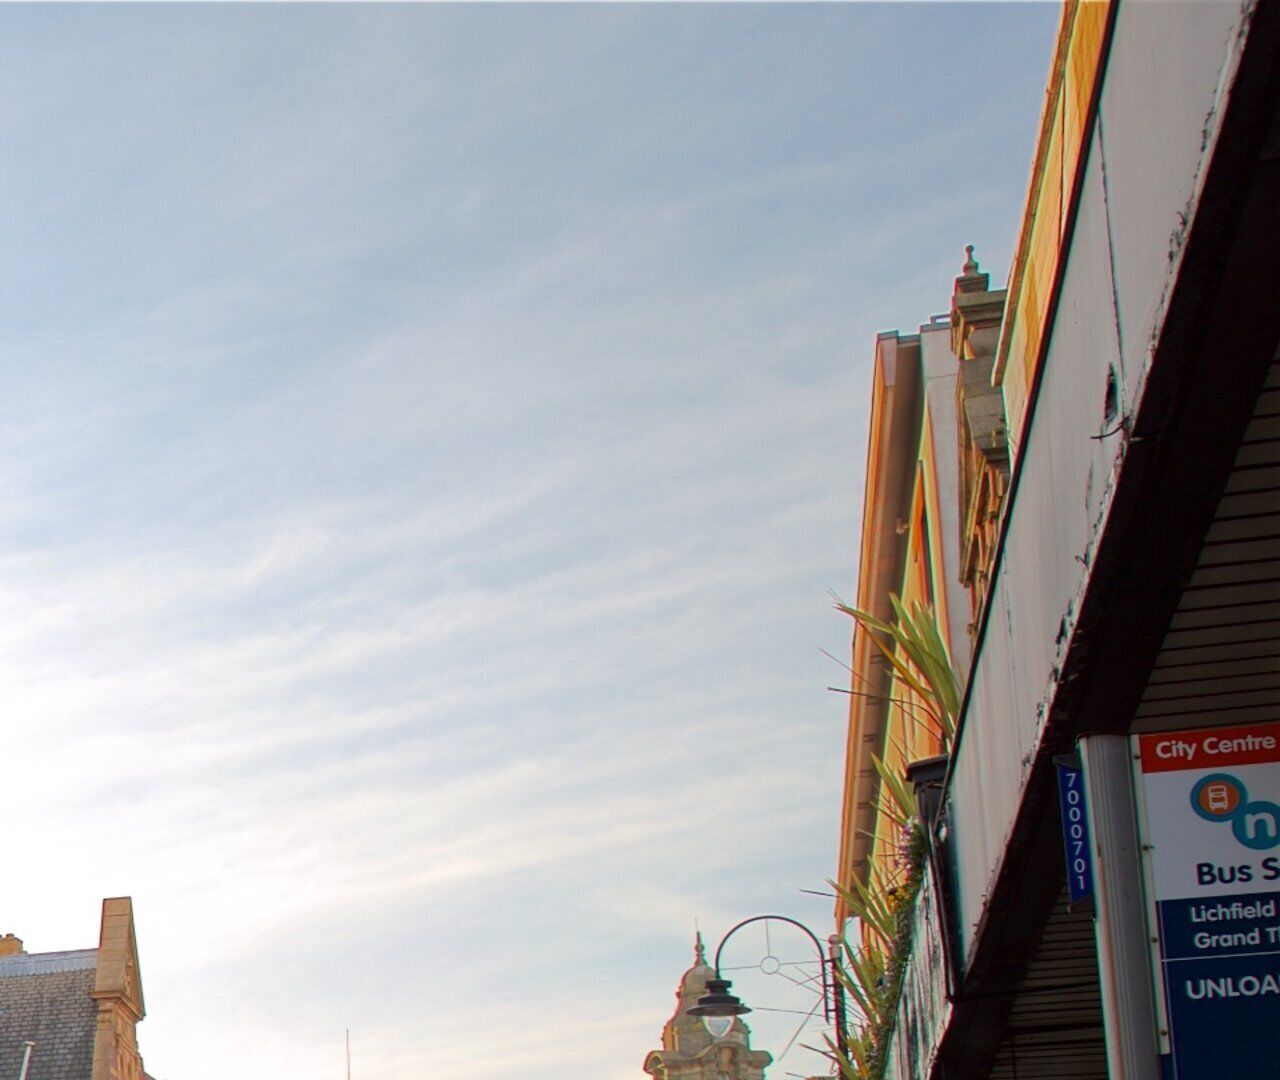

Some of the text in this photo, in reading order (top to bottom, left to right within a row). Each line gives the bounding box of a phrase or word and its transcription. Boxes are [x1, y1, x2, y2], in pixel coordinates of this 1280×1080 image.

[1155, 734, 1277, 761] City Centre
[1065, 772, 1086, 890] 7000701
[1196, 862, 1253, 886] Bus
[1191, 900, 1276, 923] Lichfield
[1194, 924, 1280, 949] Grand T
[1186, 973, 1280, 1000] UNLOA
